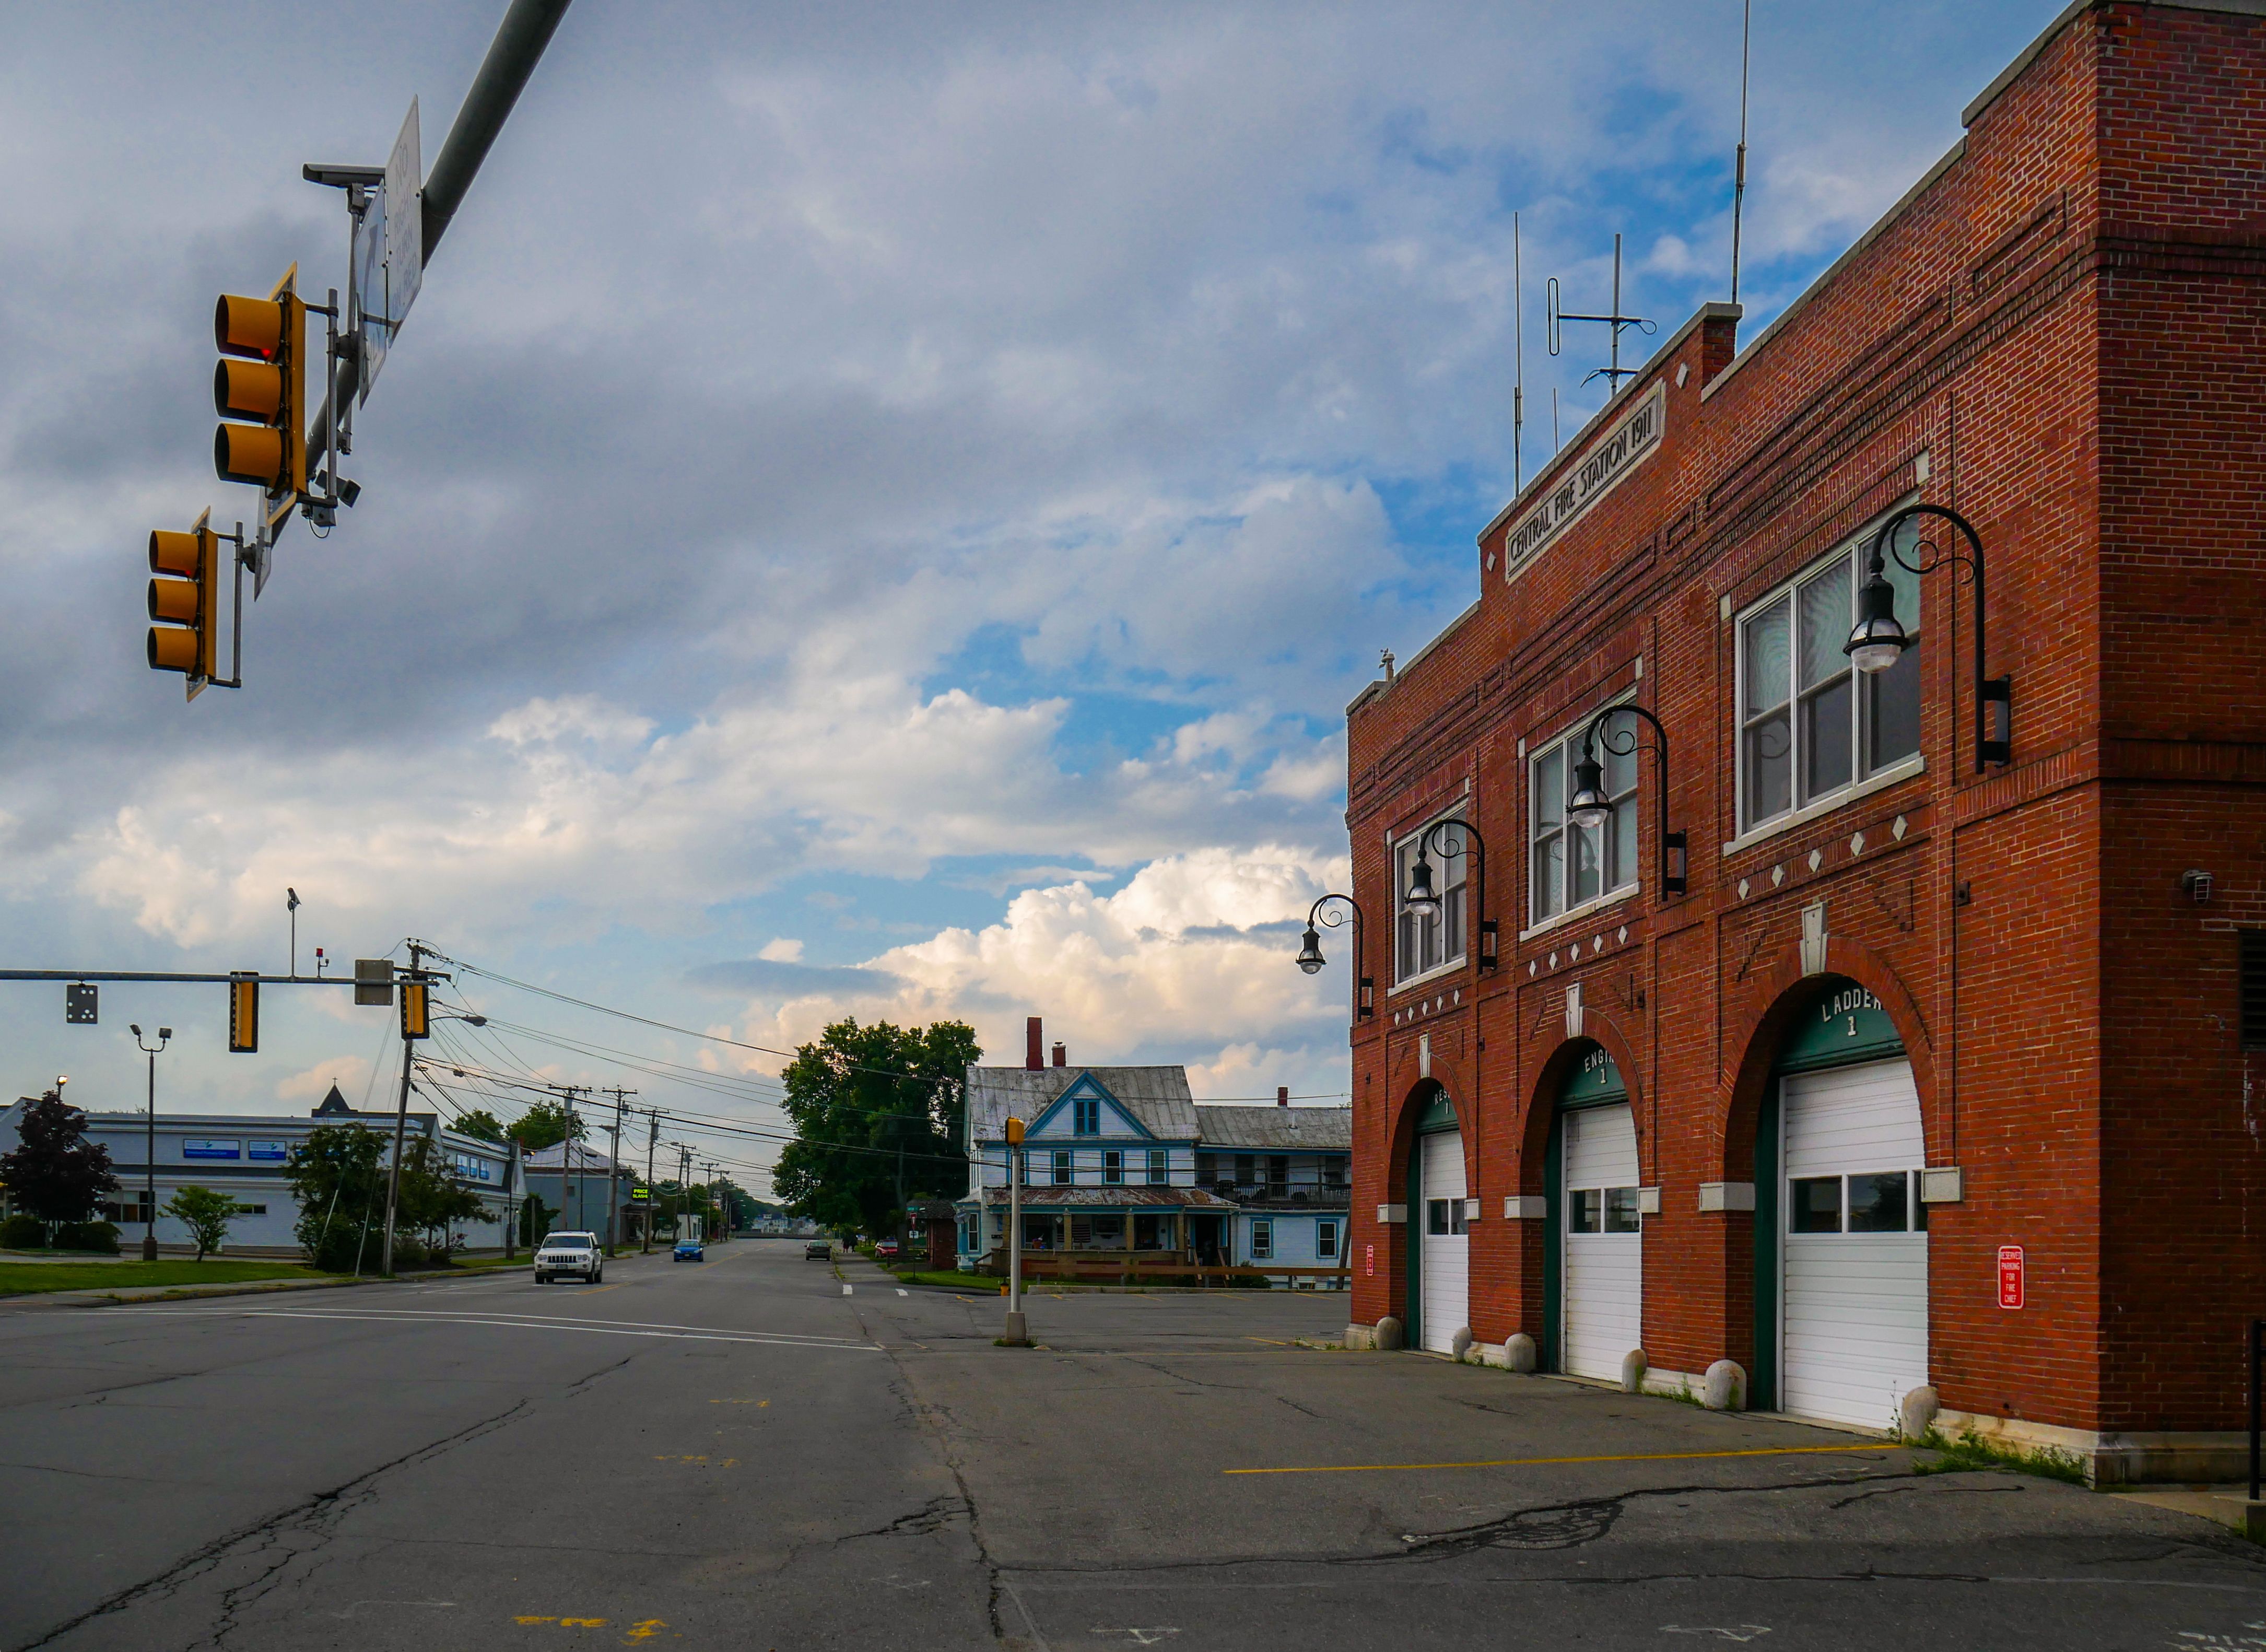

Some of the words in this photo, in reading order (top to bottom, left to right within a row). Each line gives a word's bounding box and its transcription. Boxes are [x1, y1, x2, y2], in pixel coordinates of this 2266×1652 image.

[396, 142, 408, 196] NO
[395, 177, 412, 240] RIGHT
[396, 218, 413, 273] TURN
[393, 281, 402, 319] ON
[404, 251, 417, 297] RED
[362, 323, 381, 384] ONLY
[1511, 506, 1552, 560] CENTRAL
[1555, 479, 1576, 521] FIRE
[1580, 430, 1626, 496] STATION
[1631, 407, 1651, 448] 1911
[1848, 1016, 1857, 1036] 1
[1600, 1069, 1606, 1084] 1
